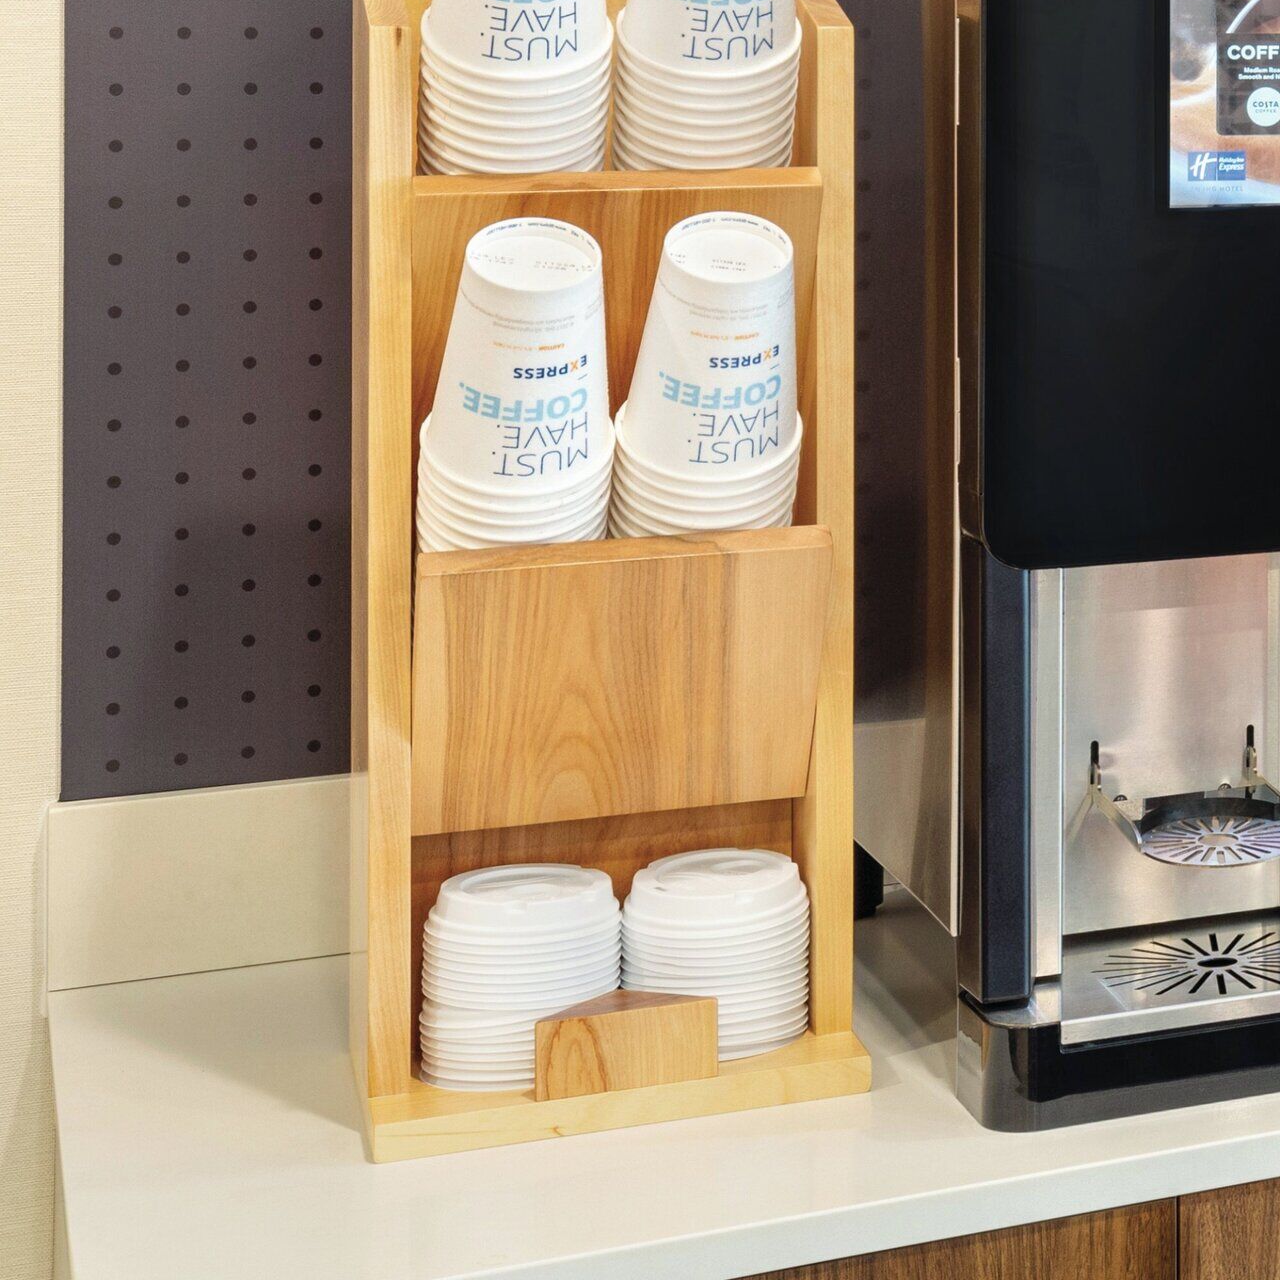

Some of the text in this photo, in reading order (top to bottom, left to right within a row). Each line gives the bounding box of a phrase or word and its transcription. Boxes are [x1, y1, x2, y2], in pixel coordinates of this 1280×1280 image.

[484, 1, 577, 33] HAVE.
[685, 1, 774, 33] HAVE.
[480, 28, 578, 62] MUST.
[681, 28, 774, 62] MUST.
[513, 354, 588, 380] EXPRESS
[709, 345, 780, 369] EXPRESS
[496, 411, 588, 449] HAVE.
[692, 400, 780, 437] HAVE.
[492, 437, 588, 477] MUST.
[687, 426, 780, 464] MUST.
